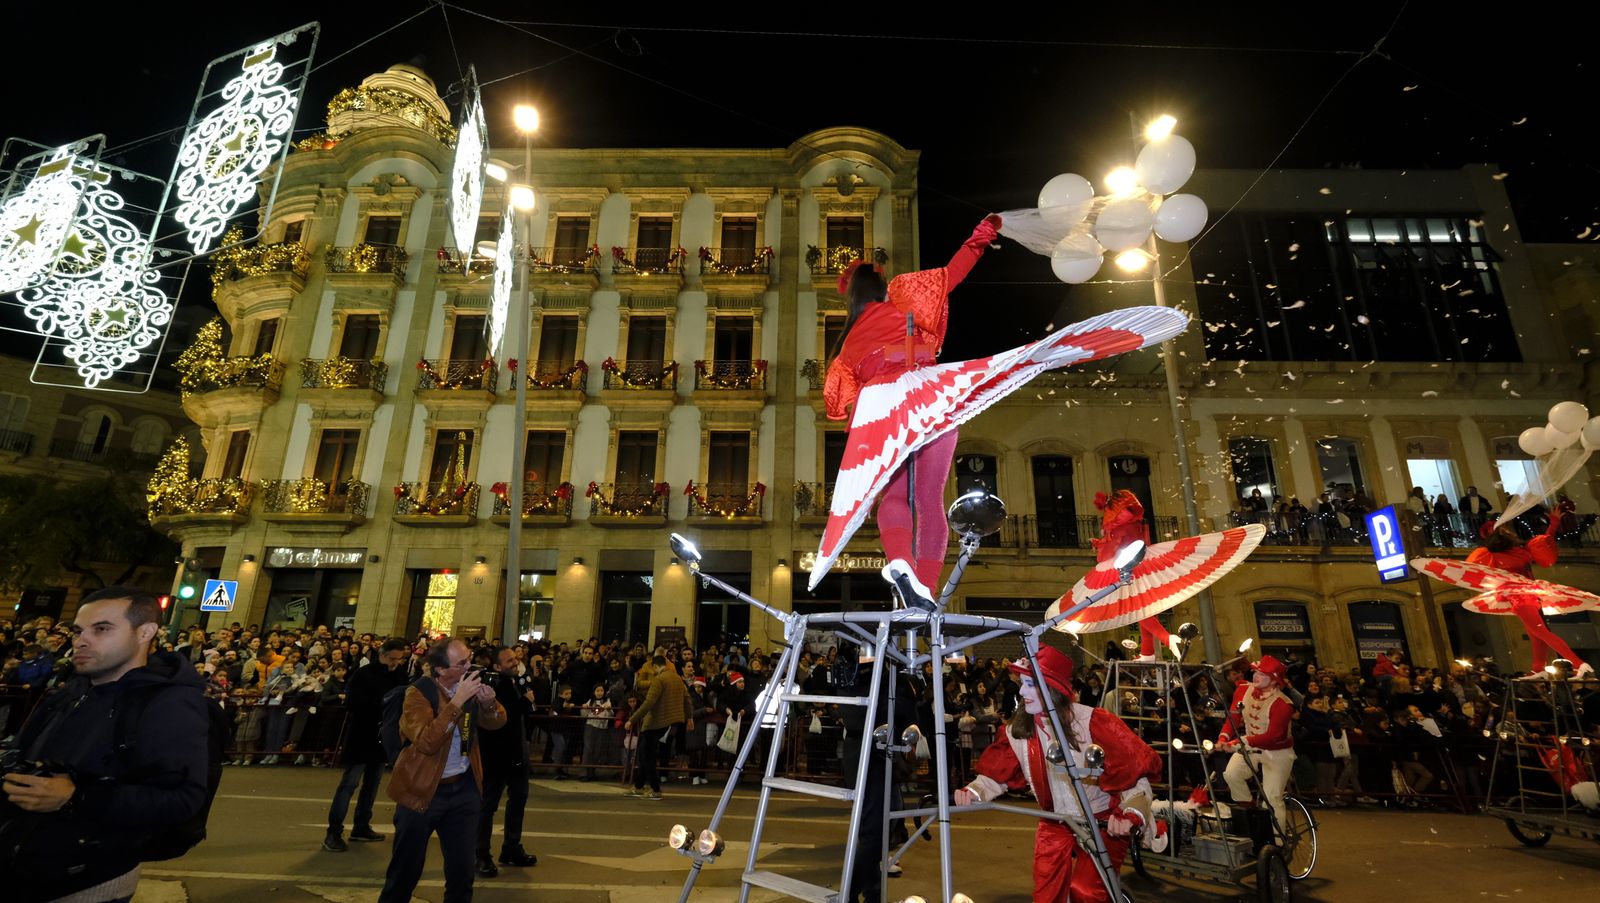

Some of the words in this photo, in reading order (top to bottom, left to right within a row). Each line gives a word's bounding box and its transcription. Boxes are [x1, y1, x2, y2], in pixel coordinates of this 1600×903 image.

[1372, 514, 1392, 557] P
[295, 548, 362, 568] cajamar
[833, 553, 888, 572] ajama
